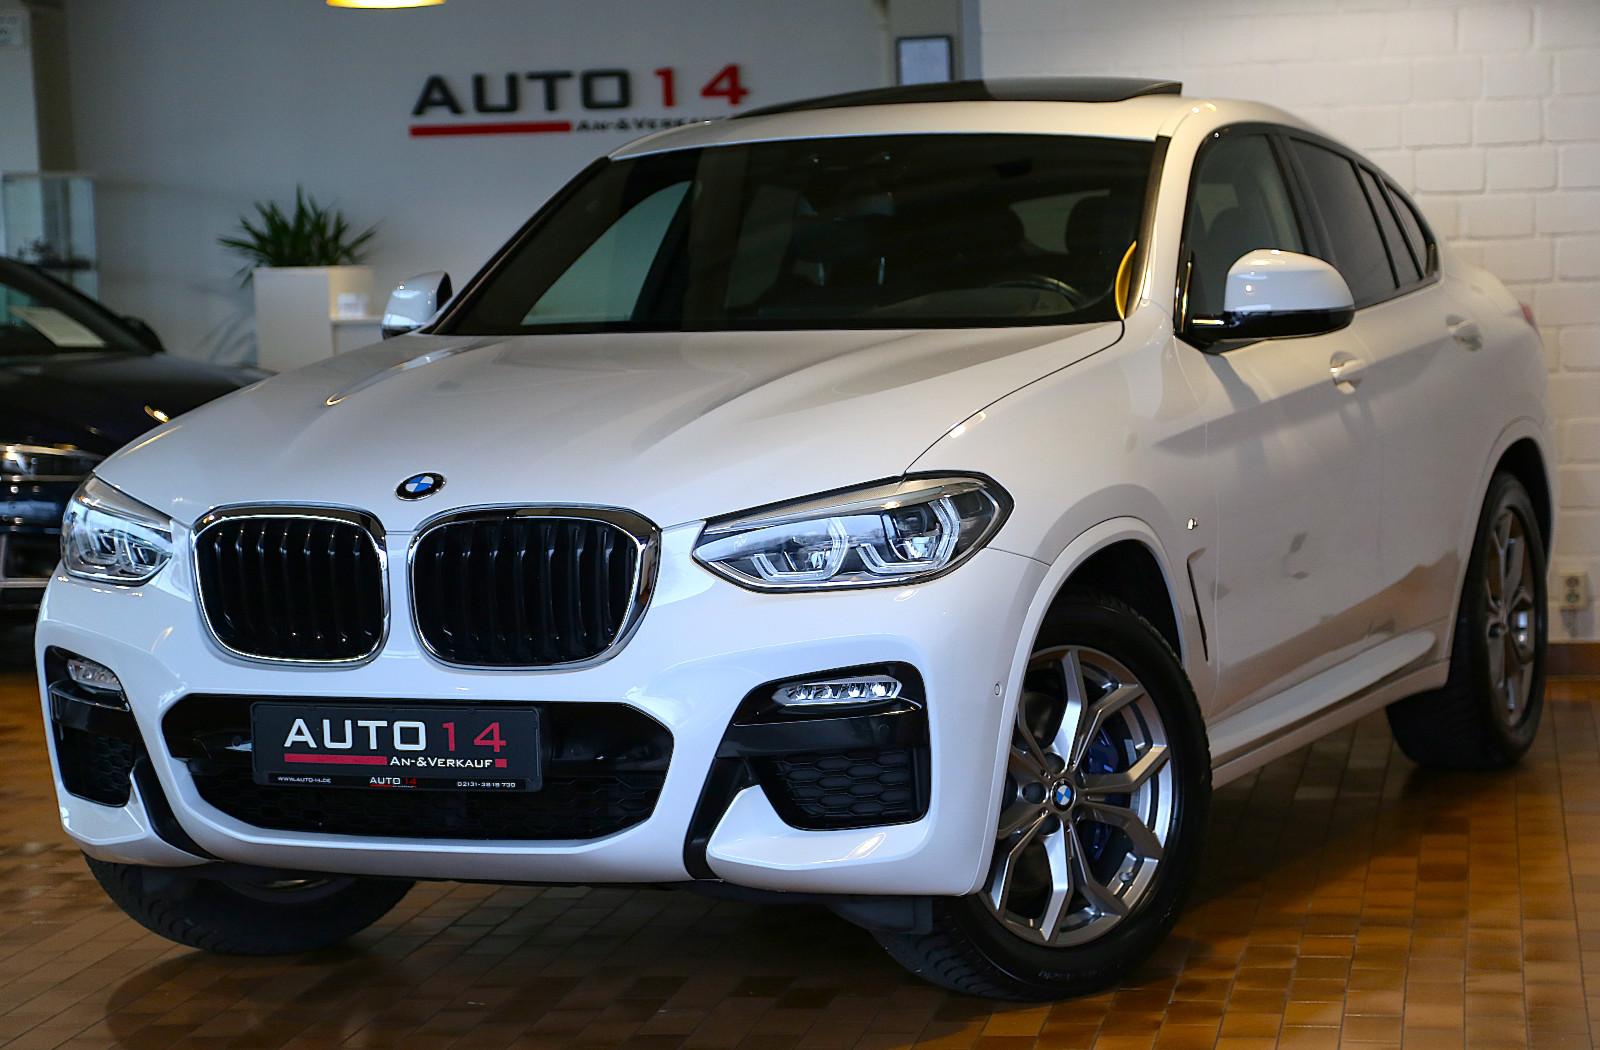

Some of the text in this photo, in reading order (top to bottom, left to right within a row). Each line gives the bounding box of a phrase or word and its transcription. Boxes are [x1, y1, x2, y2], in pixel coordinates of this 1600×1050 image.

[411, 69, 632, 116] AUTO
[283, 718, 507, 752] AUTO 14
[369, 776, 401, 785] AUTO
